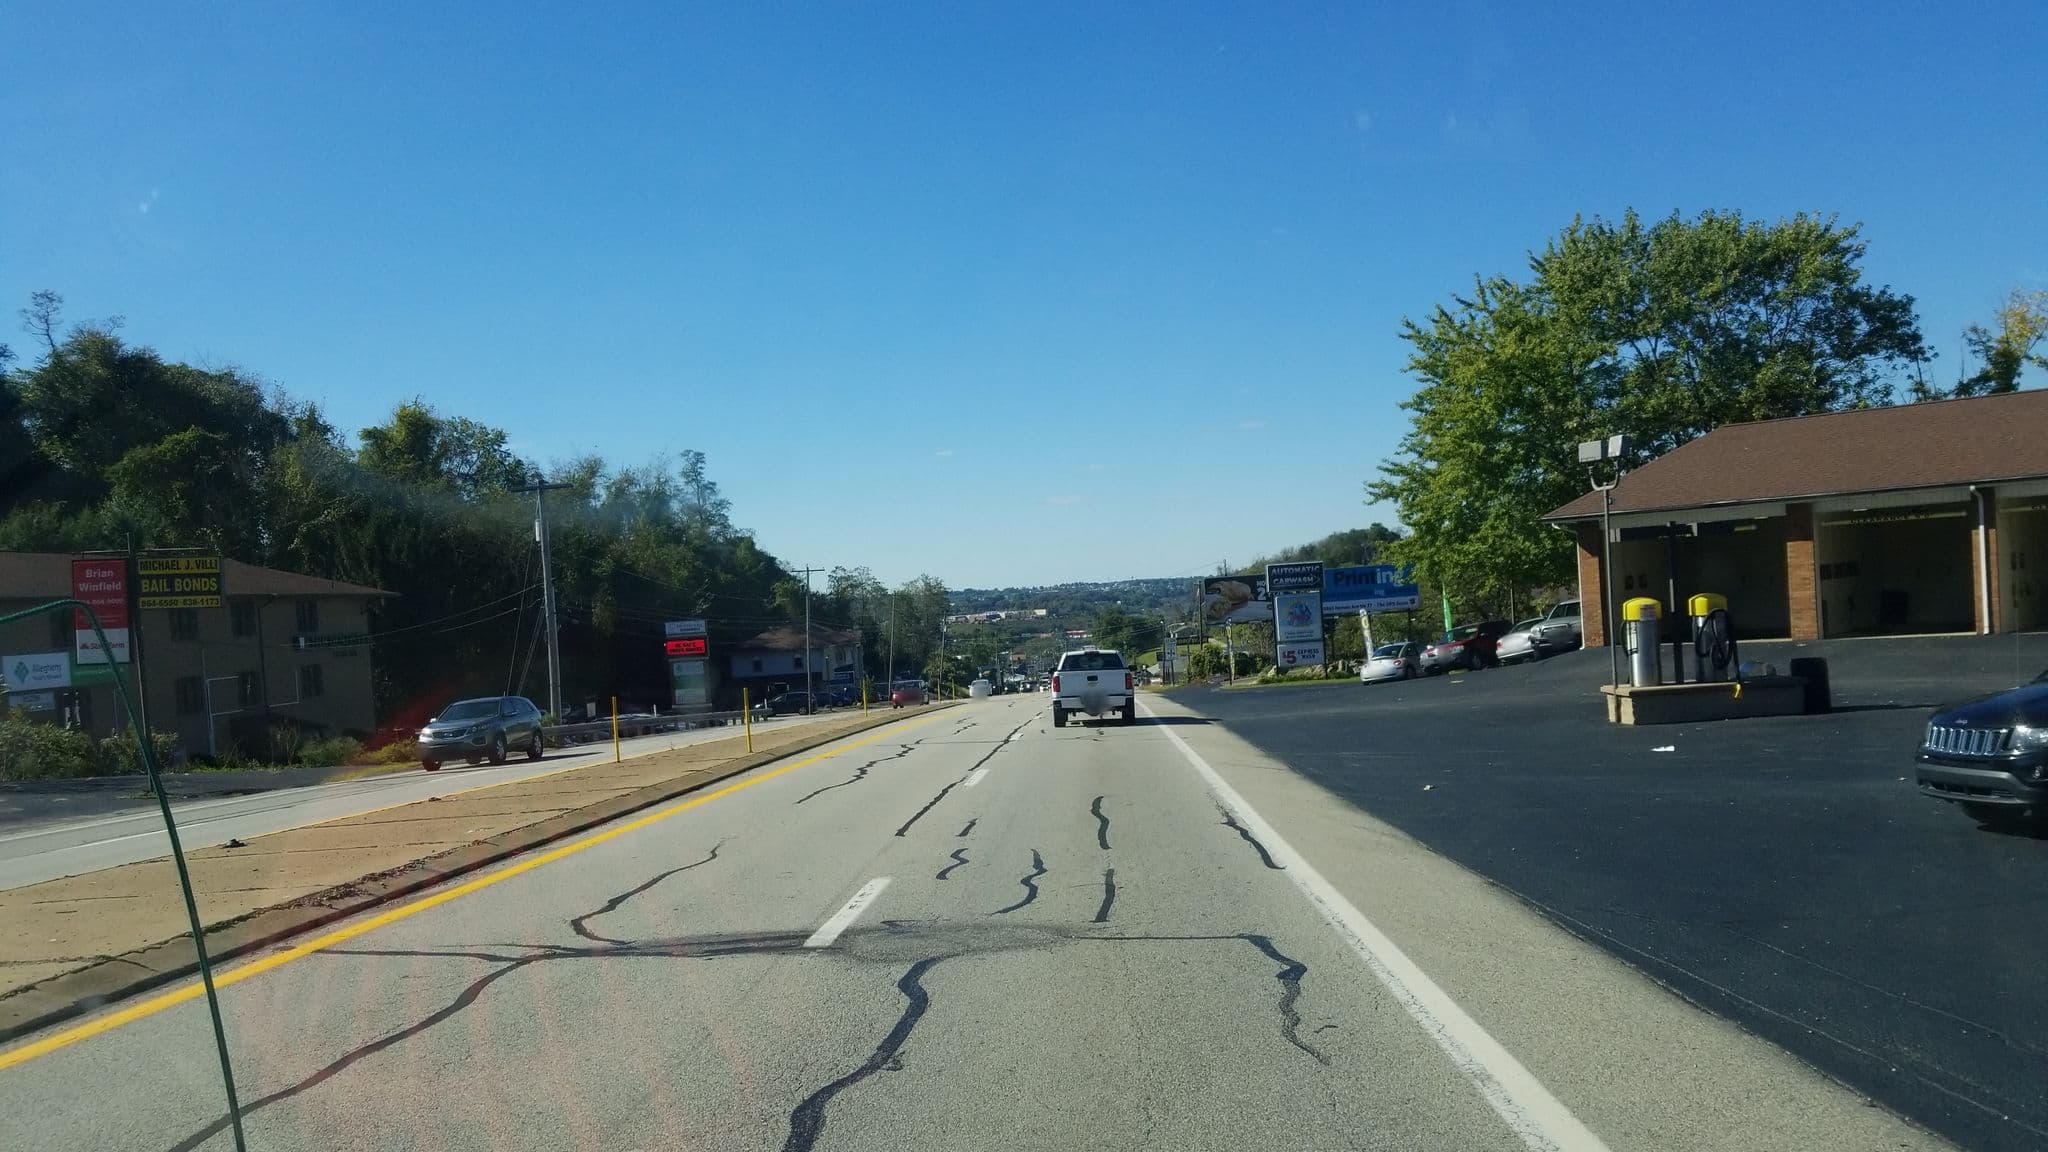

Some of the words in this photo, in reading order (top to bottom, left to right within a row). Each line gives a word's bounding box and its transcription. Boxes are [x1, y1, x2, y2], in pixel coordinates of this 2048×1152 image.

[140, 560, 184, 571] MICHAEL
[1272, 565, 1320, 576] AUTOMATIC
[86, 569, 113, 578] Brian
[1335, 568, 1405, 587] Printing
[79, 581, 122, 592] Winfield
[142, 578, 171, 592] BAIL
[175, 577, 218, 592] BONDS
[1273, 576, 1314, 586] CARWASH
